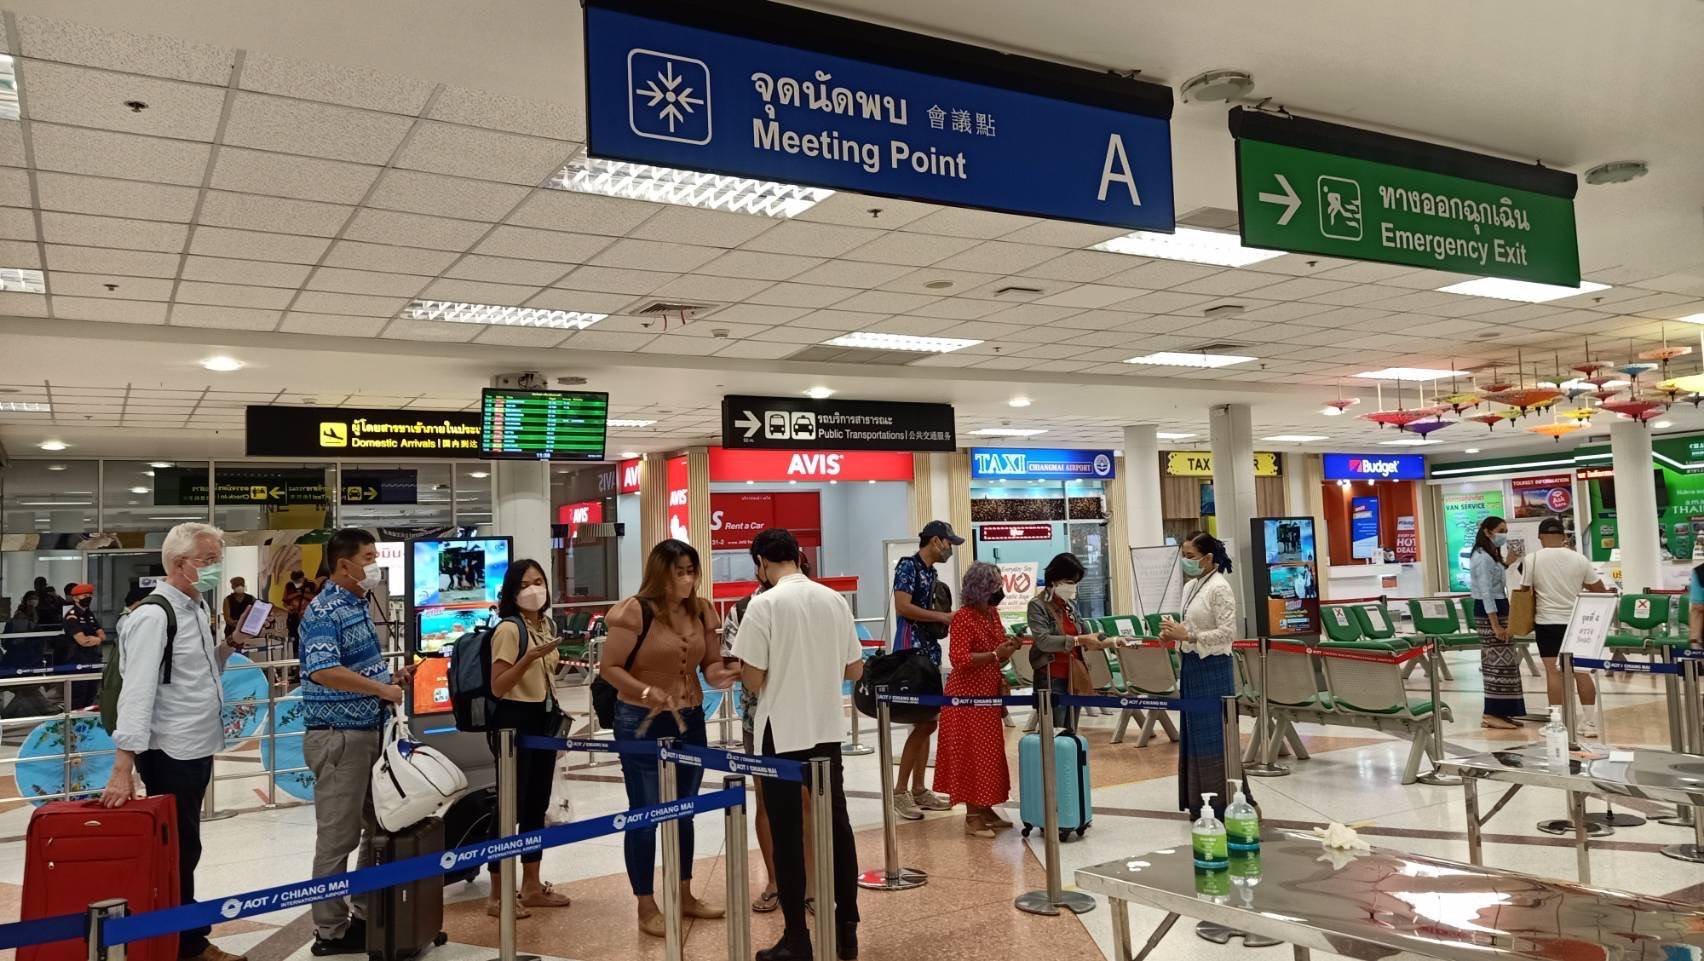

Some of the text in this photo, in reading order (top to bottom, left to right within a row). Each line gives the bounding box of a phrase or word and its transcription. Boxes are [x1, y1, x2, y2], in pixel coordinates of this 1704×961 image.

[751, 70, 908, 125] จุดนัดพบ
[926, 103, 997, 138] 會議點
[752, 117, 967, 180] Meeting Point
[1096, 132, 1143, 207] A
[1378, 185, 1531, 235] ทางออกฉุกเฉิน
[1381, 222, 1528, 266] Emergency Exit
[351, 437, 398, 448] Domestic
[400, 438, 437, 448] Arrivals
[818, 429, 844, 439] Public
[844, 429, 905, 441] Transportations
[787, 453, 842, 475] AVIS
[974, 453, 1027, 474] TAXI
[1065, 462, 1092, 472] AIRPORT
[1187, 458, 1211, 471] TAX
[1362, 459, 1399, 477] Budget
[1460, 502, 1486, 510] SERVICE
[725, 522, 743, 530] Rent
[750, 522, 765, 530] Car
[626, 813, 643, 824] AOT
[650, 805, 680, 818] CHIANG
[680, 801, 694, 811] MAI
[457, 849, 479, 861] AOT
[487, 839, 523, 854] CHIANG
[525, 835, 542, 845] MAI
[242, 896, 270, 910] AOT
[280, 884, 326, 901] CHIANG
[328, 879, 350, 891] MAI
[280, 889, 349, 907] INTERNATIONAL AIRPORT
